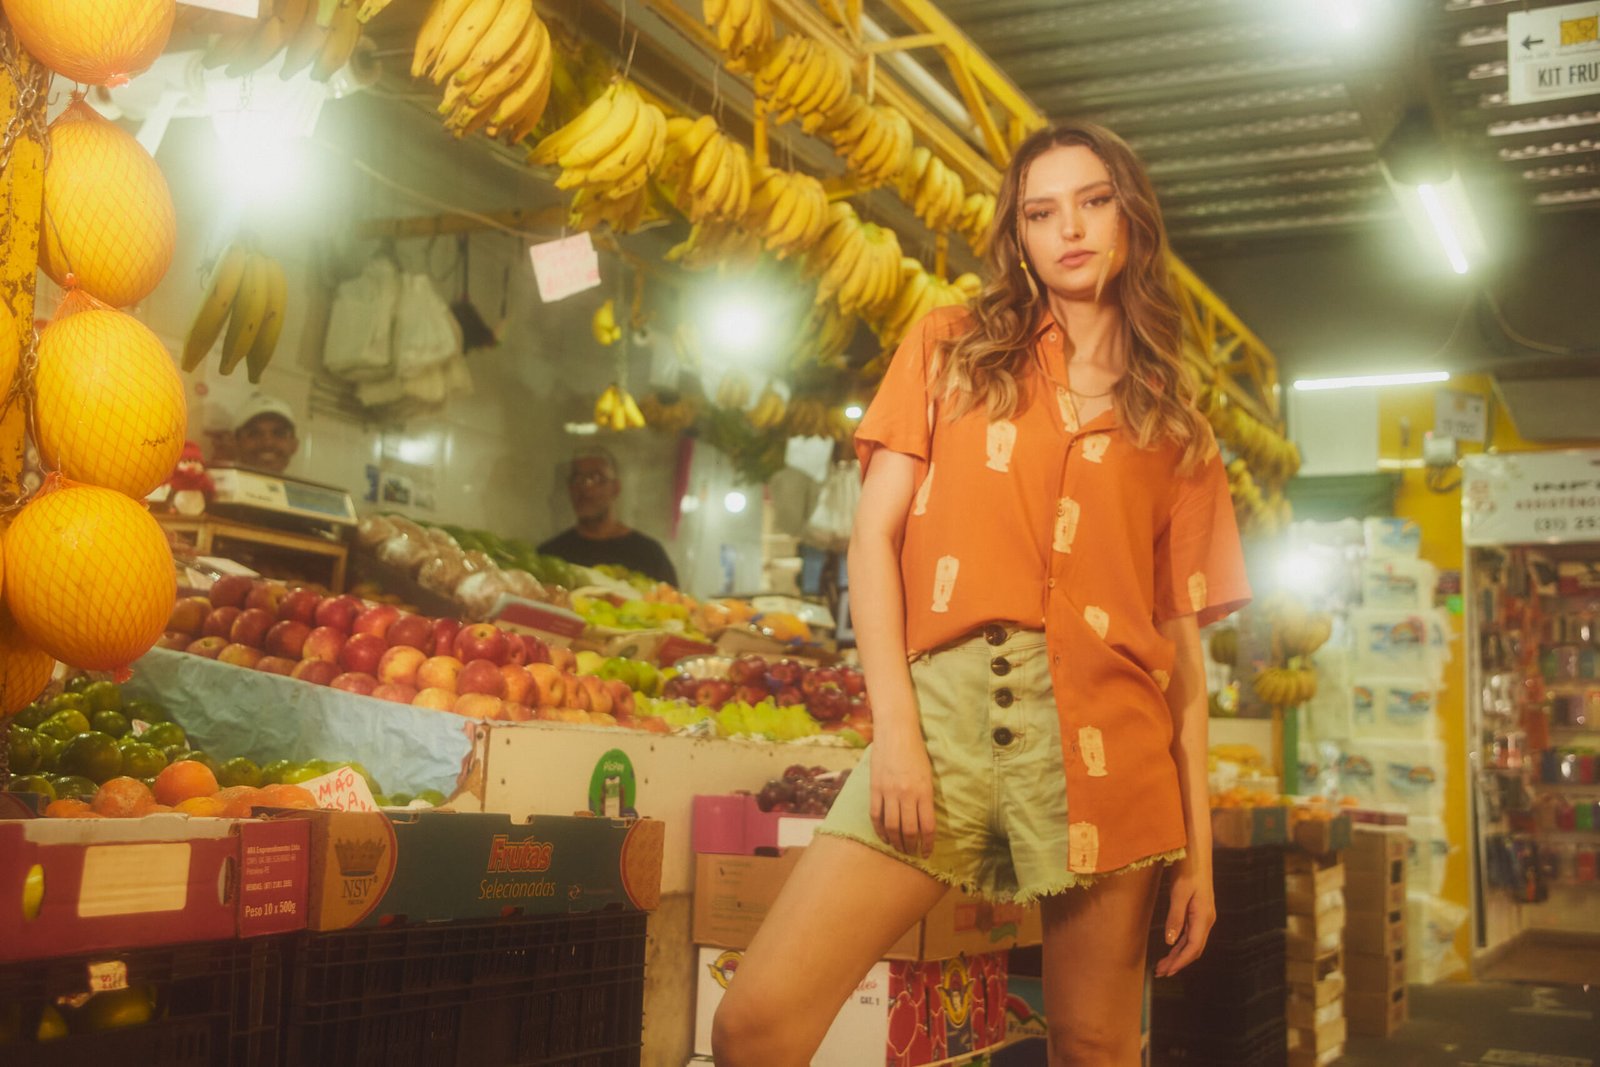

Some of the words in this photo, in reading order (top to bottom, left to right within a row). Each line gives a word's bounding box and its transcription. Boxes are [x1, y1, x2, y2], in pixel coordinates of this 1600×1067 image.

[1538, 65, 1562, 87] KIT
[340, 878, 373, 898] NSV
[478, 878, 556, 899] Selecionadas
[244, 904, 263, 918] Peso
[264, 902, 273, 915] 10
[274, 905, 279, 914] x
[279, 900, 297, 915] 500g
